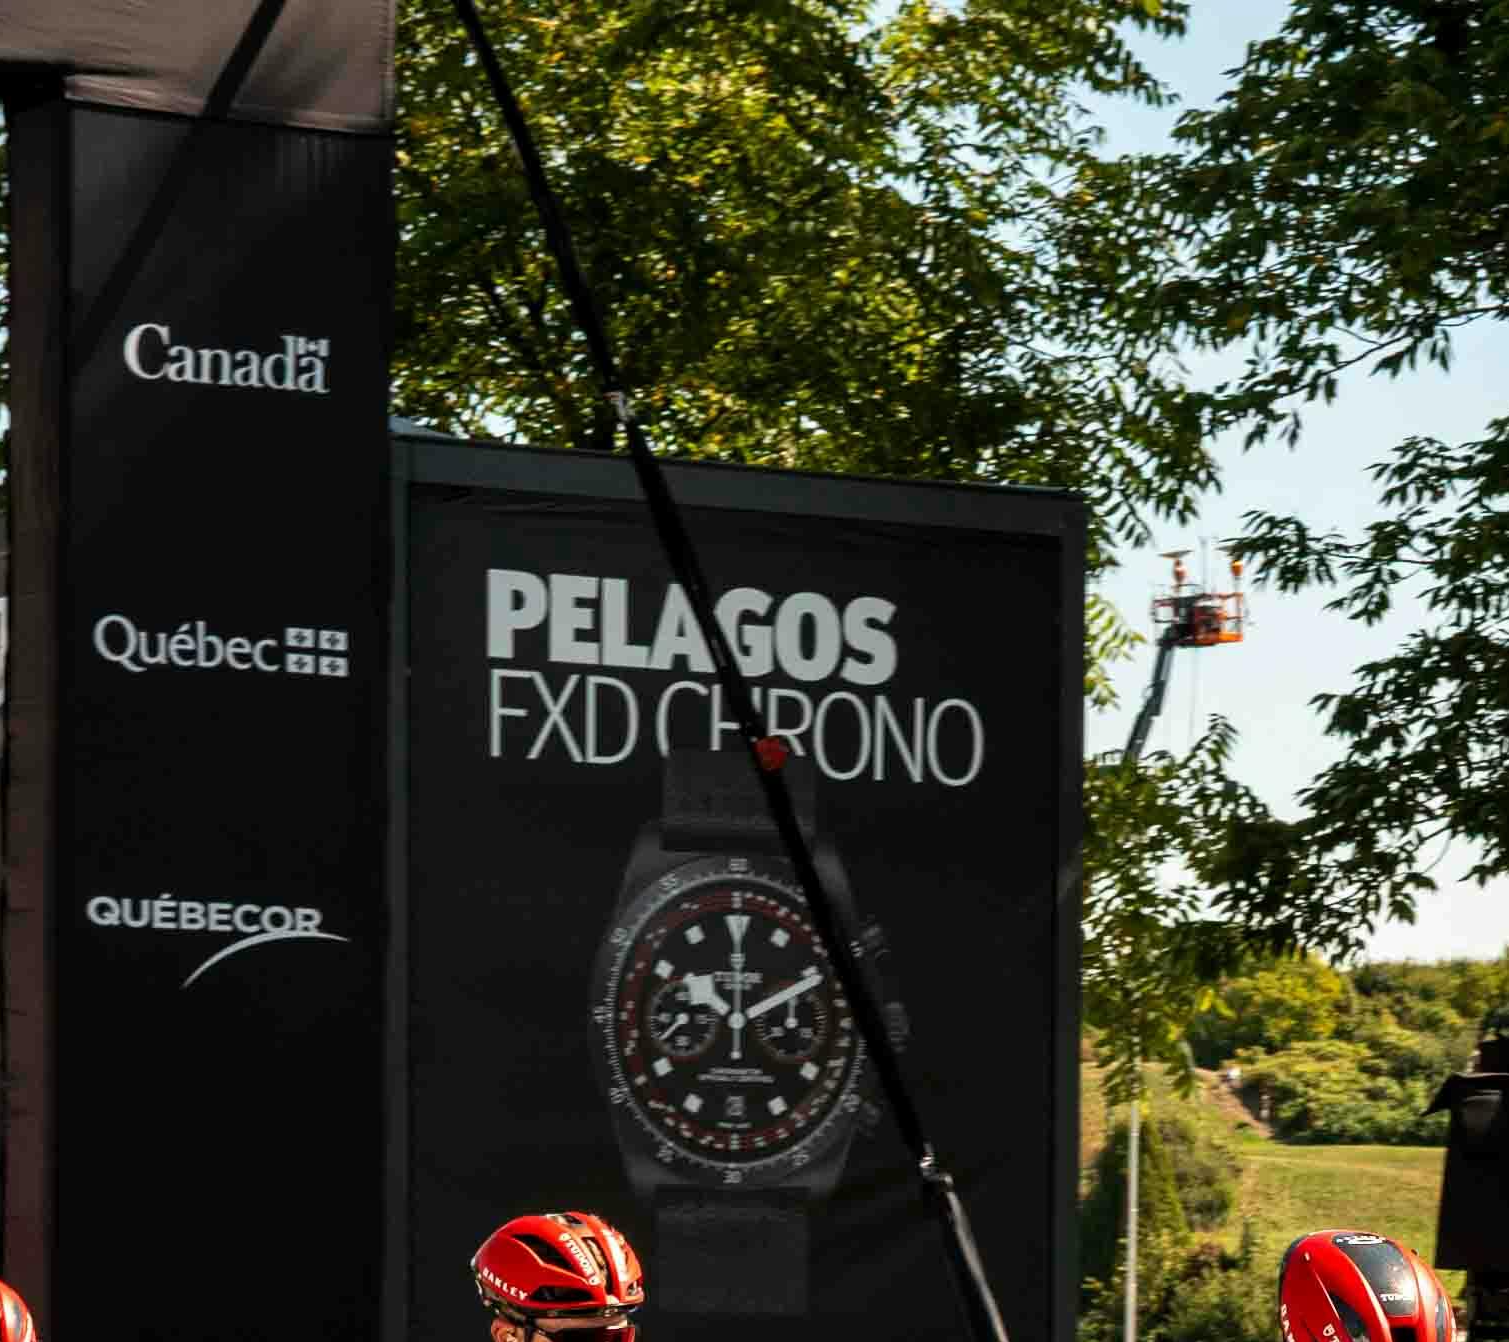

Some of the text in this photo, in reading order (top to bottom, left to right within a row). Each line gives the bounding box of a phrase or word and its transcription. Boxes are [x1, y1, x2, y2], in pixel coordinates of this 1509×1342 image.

[122, 323, 330, 394] Canada
[93, 613, 279, 674] Québec
[487, 568, 897, 686] PELAGOS
[489, 668, 984, 786] FXD CHRONO
[86, 892, 322, 935] QUÉBECOR
